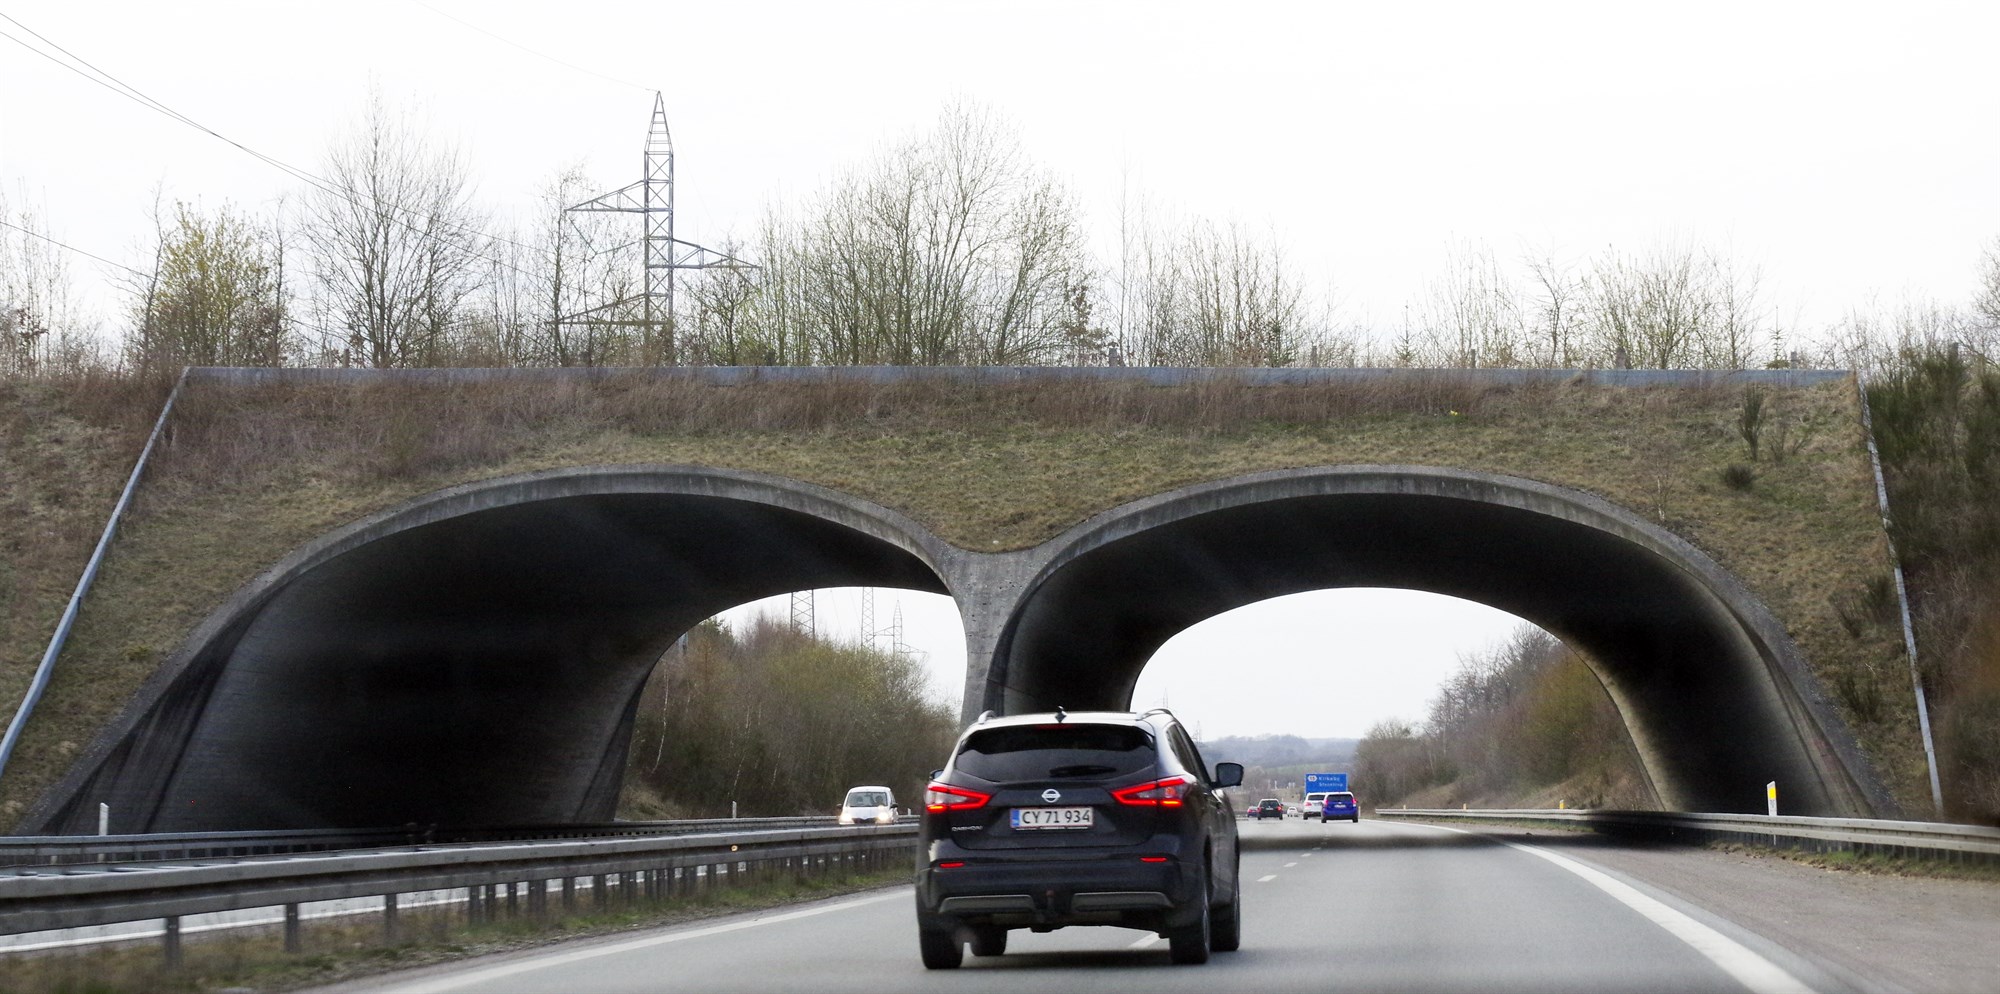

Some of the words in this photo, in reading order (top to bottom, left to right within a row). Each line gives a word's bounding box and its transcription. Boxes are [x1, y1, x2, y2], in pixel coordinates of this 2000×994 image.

[1022, 810, 1041, 824] CY
[1044, 810, 1060, 824] 71
[1064, 809, 1090, 823] 934
